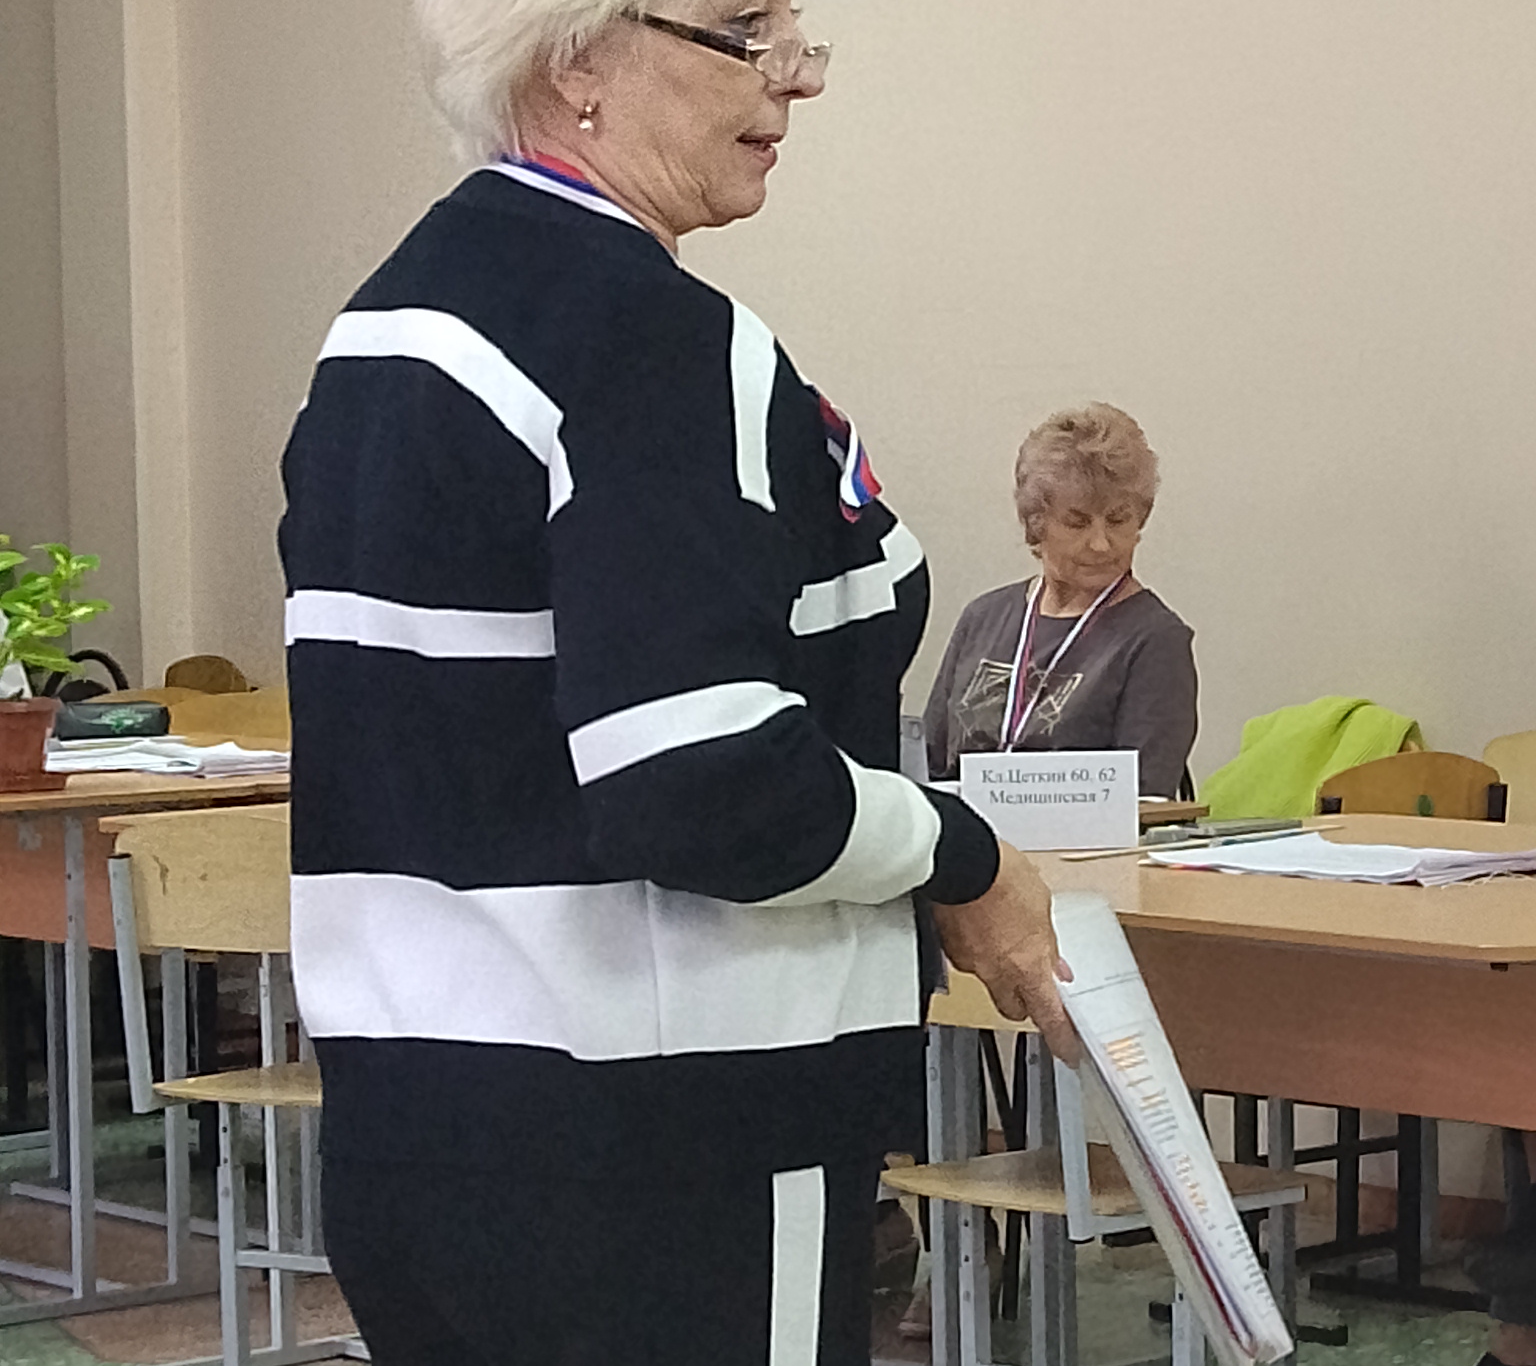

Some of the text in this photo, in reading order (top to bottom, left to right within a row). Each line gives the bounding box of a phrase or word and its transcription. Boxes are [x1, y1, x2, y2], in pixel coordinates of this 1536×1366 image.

[1098, 767, 1117, 782] 62
[989, 789, 1111, 805] Медицинская 7
